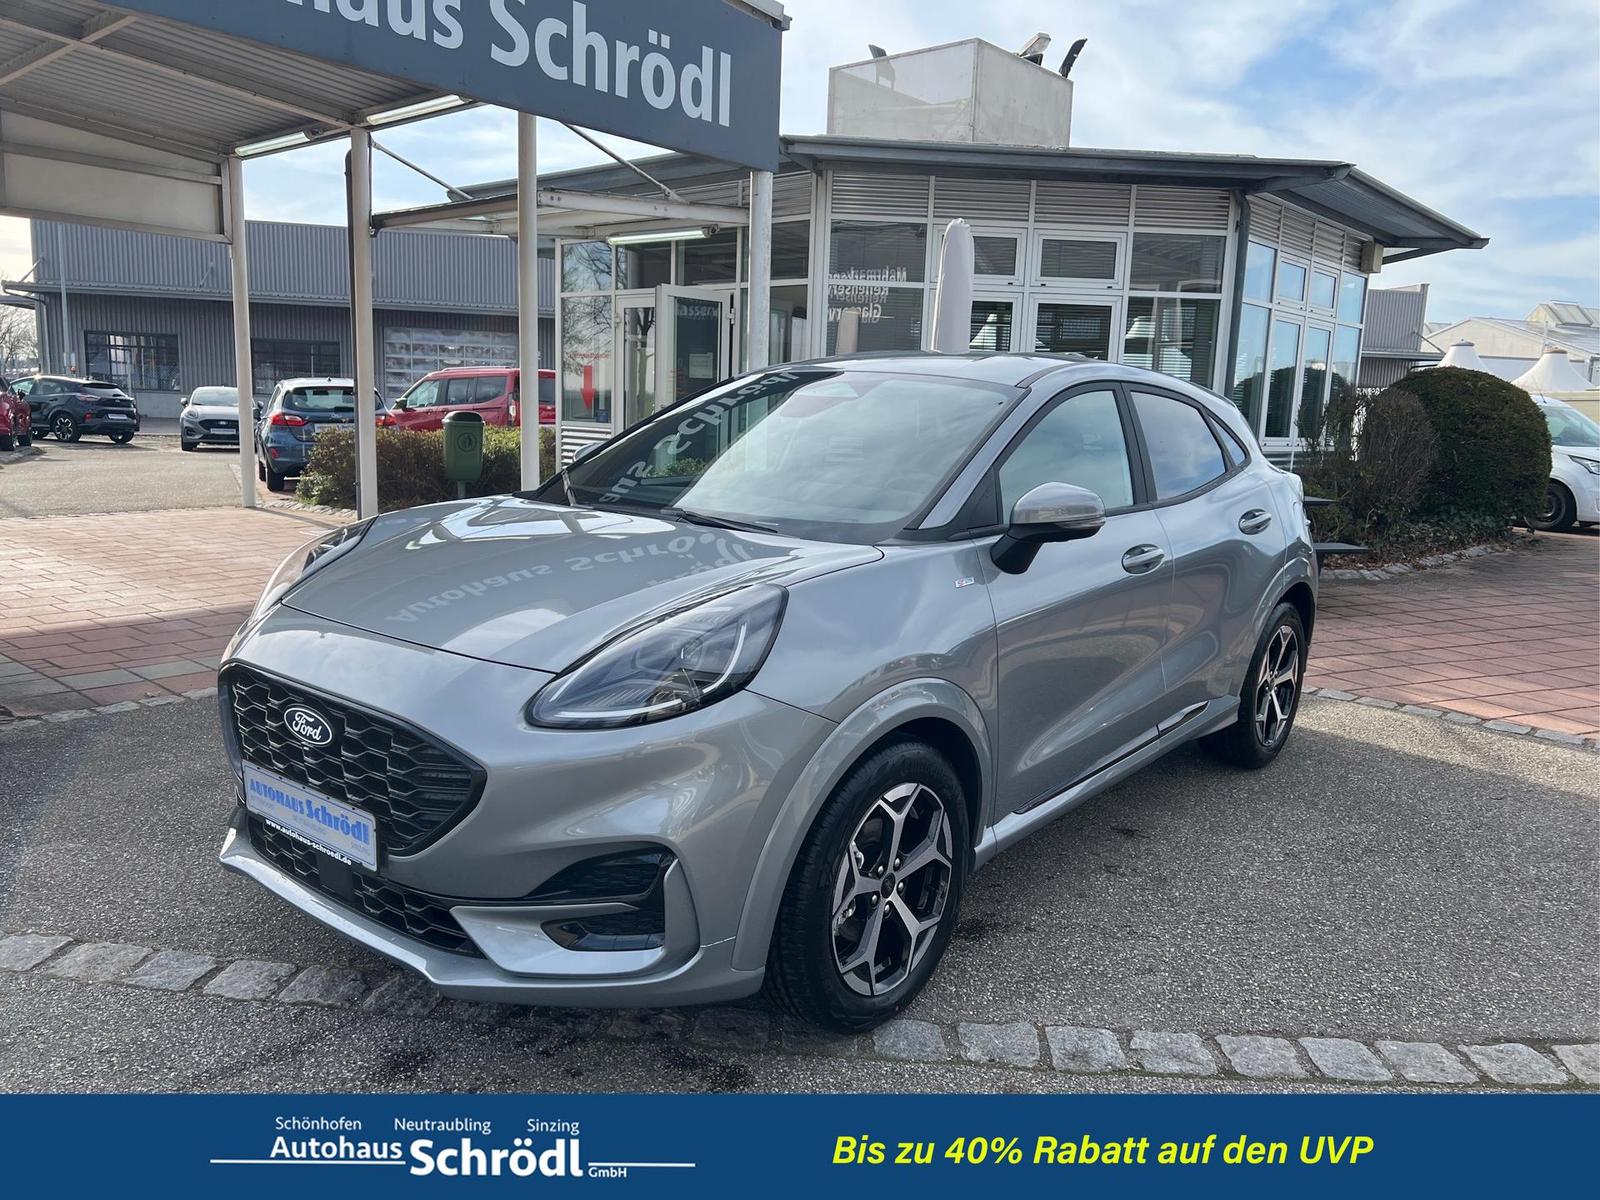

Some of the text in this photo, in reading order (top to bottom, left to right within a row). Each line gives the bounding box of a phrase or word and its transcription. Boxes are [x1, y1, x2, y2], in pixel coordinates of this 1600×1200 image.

[287, 0, 731, 127] us Schrödl
[292, 711, 322, 741] Ford
[250, 778, 305, 815] AUTOHAUS
[306, 799, 370, 845] Schrödl
[265, 819, 352, 866] www.autohaus-schroedl.de
